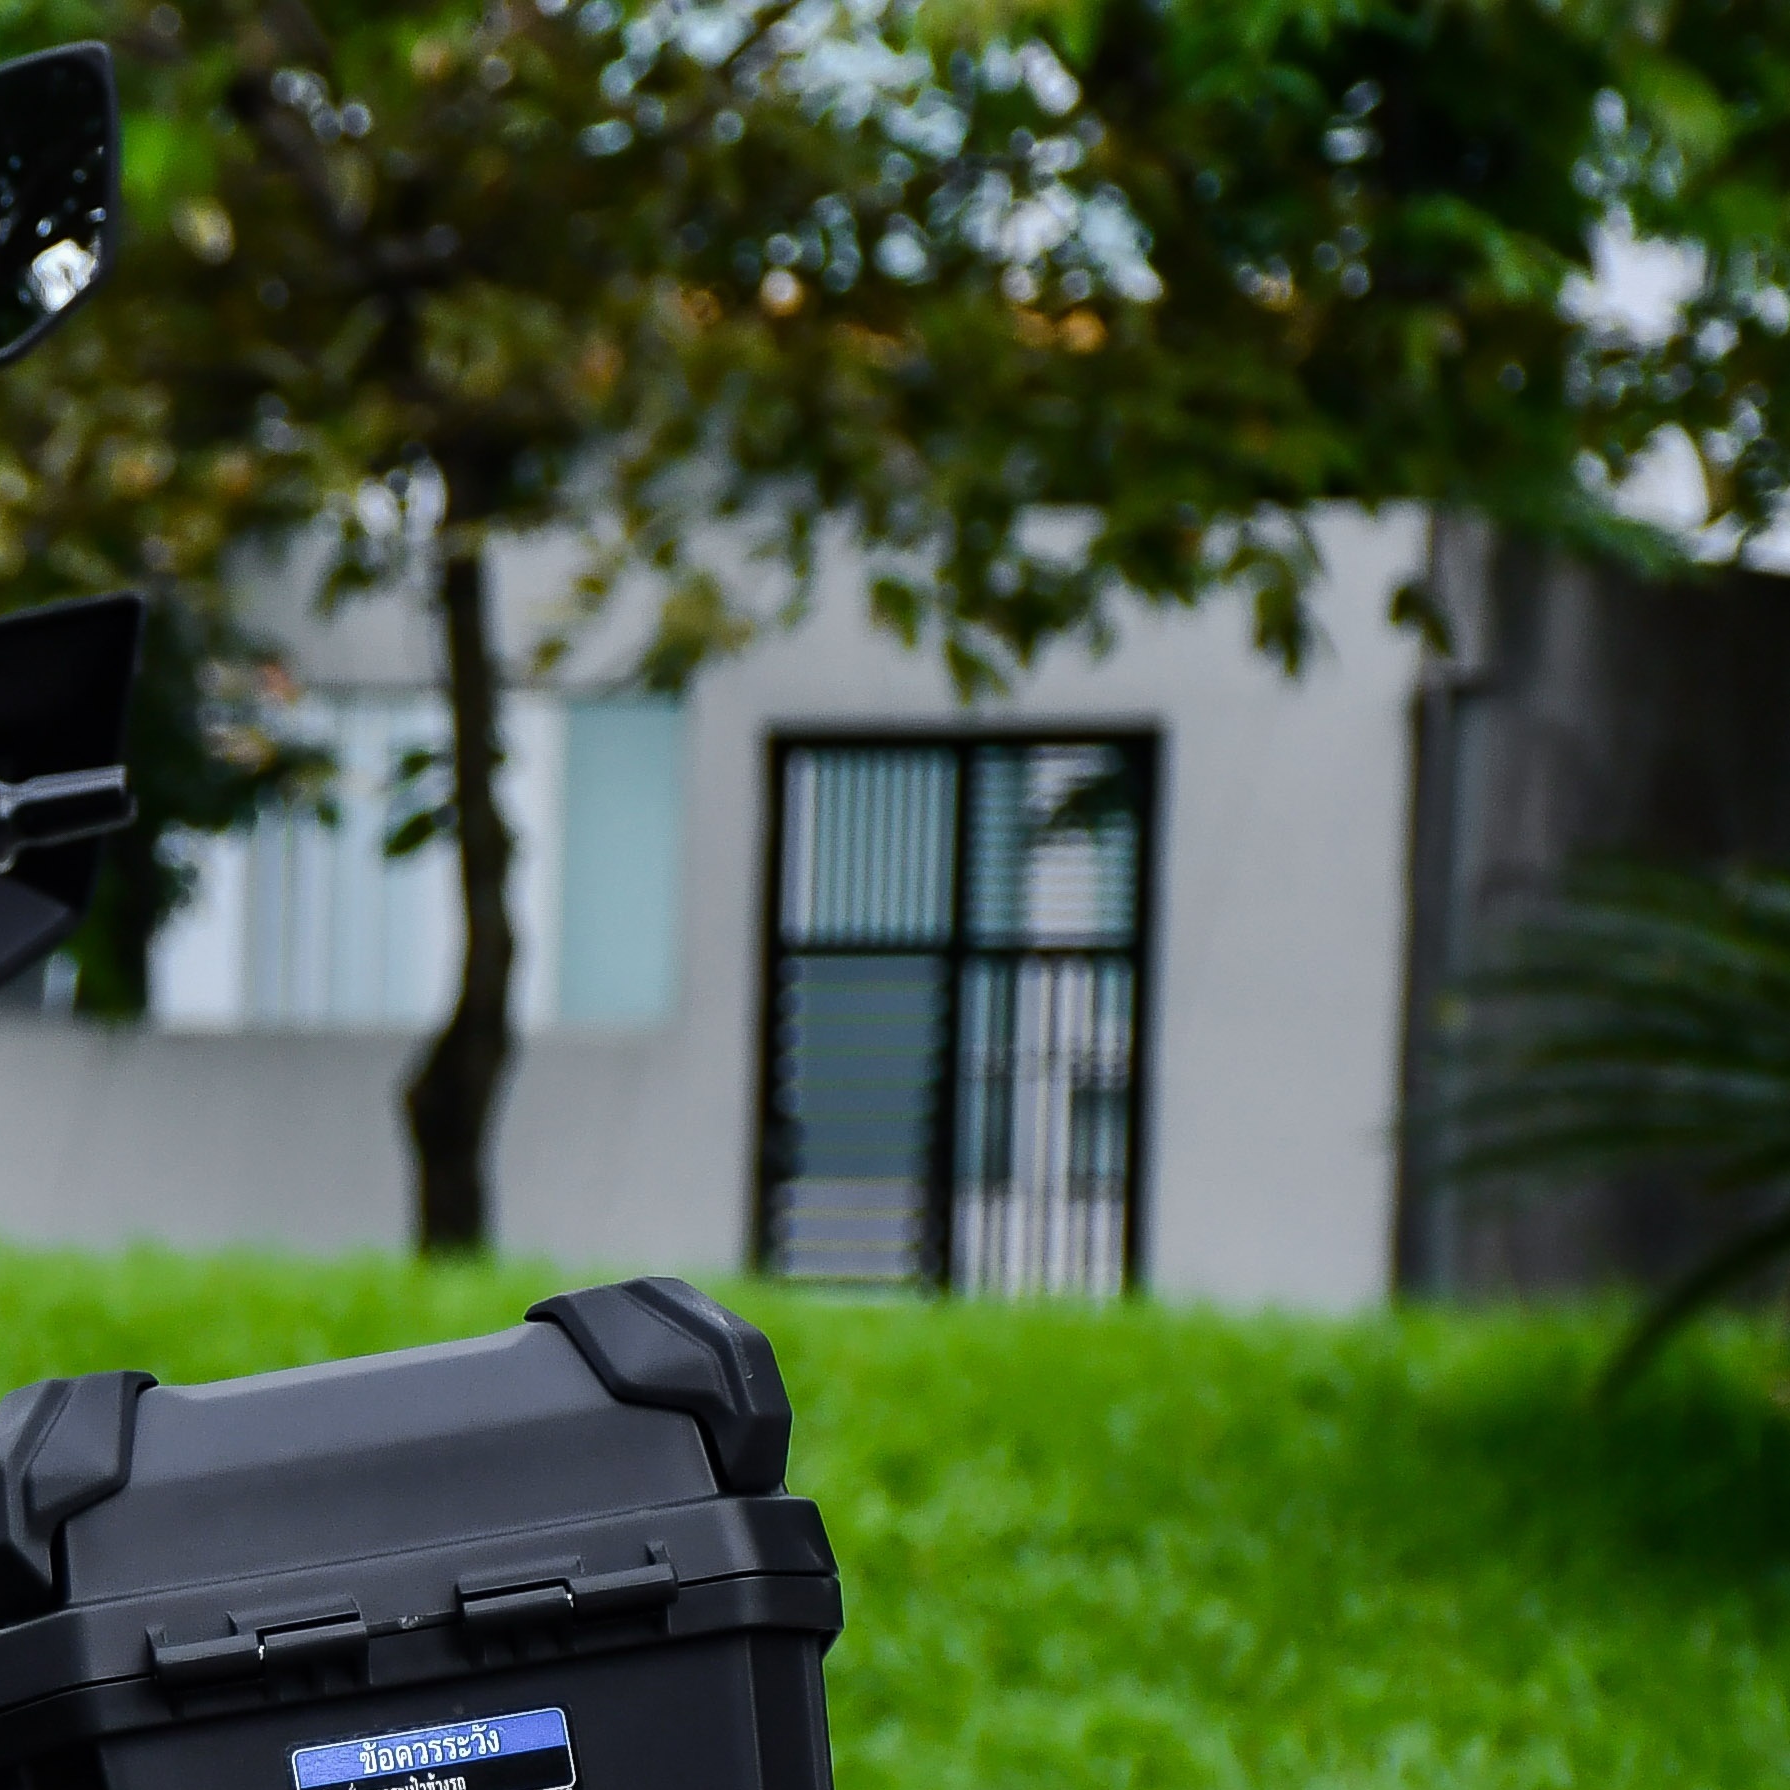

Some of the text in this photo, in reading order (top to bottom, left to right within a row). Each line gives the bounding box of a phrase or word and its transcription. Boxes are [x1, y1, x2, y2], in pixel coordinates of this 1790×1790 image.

[359, 1723, 501, 1775] ข้อควรระวัง
